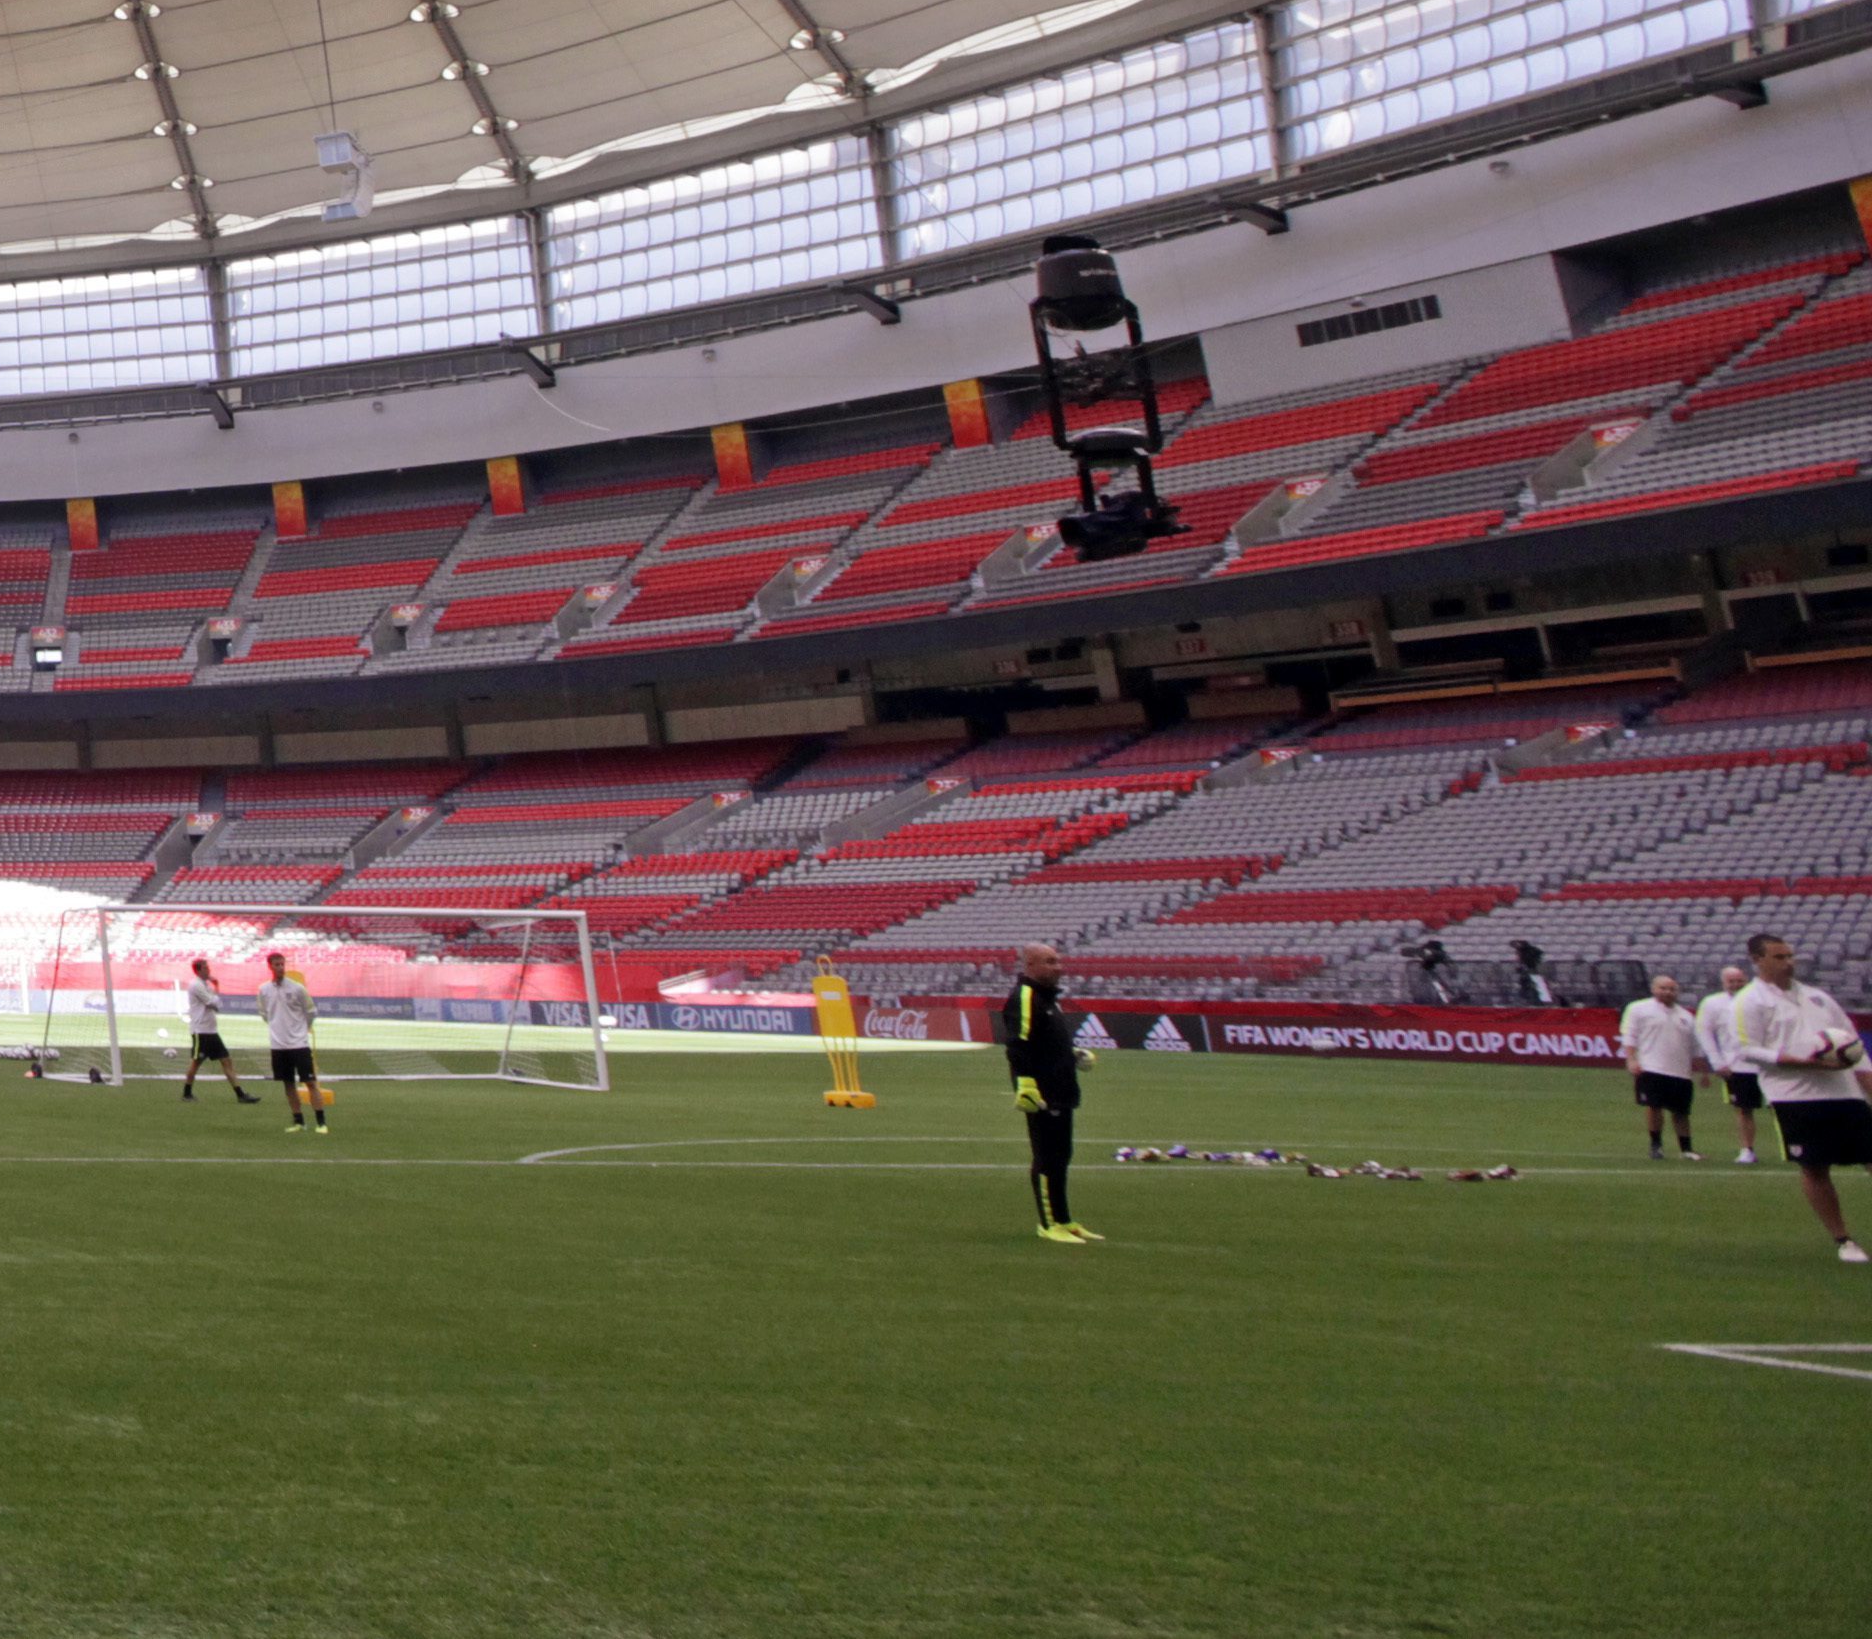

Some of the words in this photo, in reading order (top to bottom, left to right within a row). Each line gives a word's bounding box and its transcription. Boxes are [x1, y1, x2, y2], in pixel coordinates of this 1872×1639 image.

[540, 1002, 585, 1026] VISA
[603, 1003, 650, 1028] VISA
[700, 1008, 794, 1031] HYUNDAI
[1073, 1038, 1118, 1050] adidas
[1143, 1039, 1191, 1052] adidas
[1224, 1024, 1268, 1045] FIFA
[1266, 1026, 1369, 1049] WOMEN'S
[1369, 1029, 1454, 1051] WORLD
[1456, 1030, 1504, 1053] CUP
[1508, 1033, 1612, 1057] CANADA
